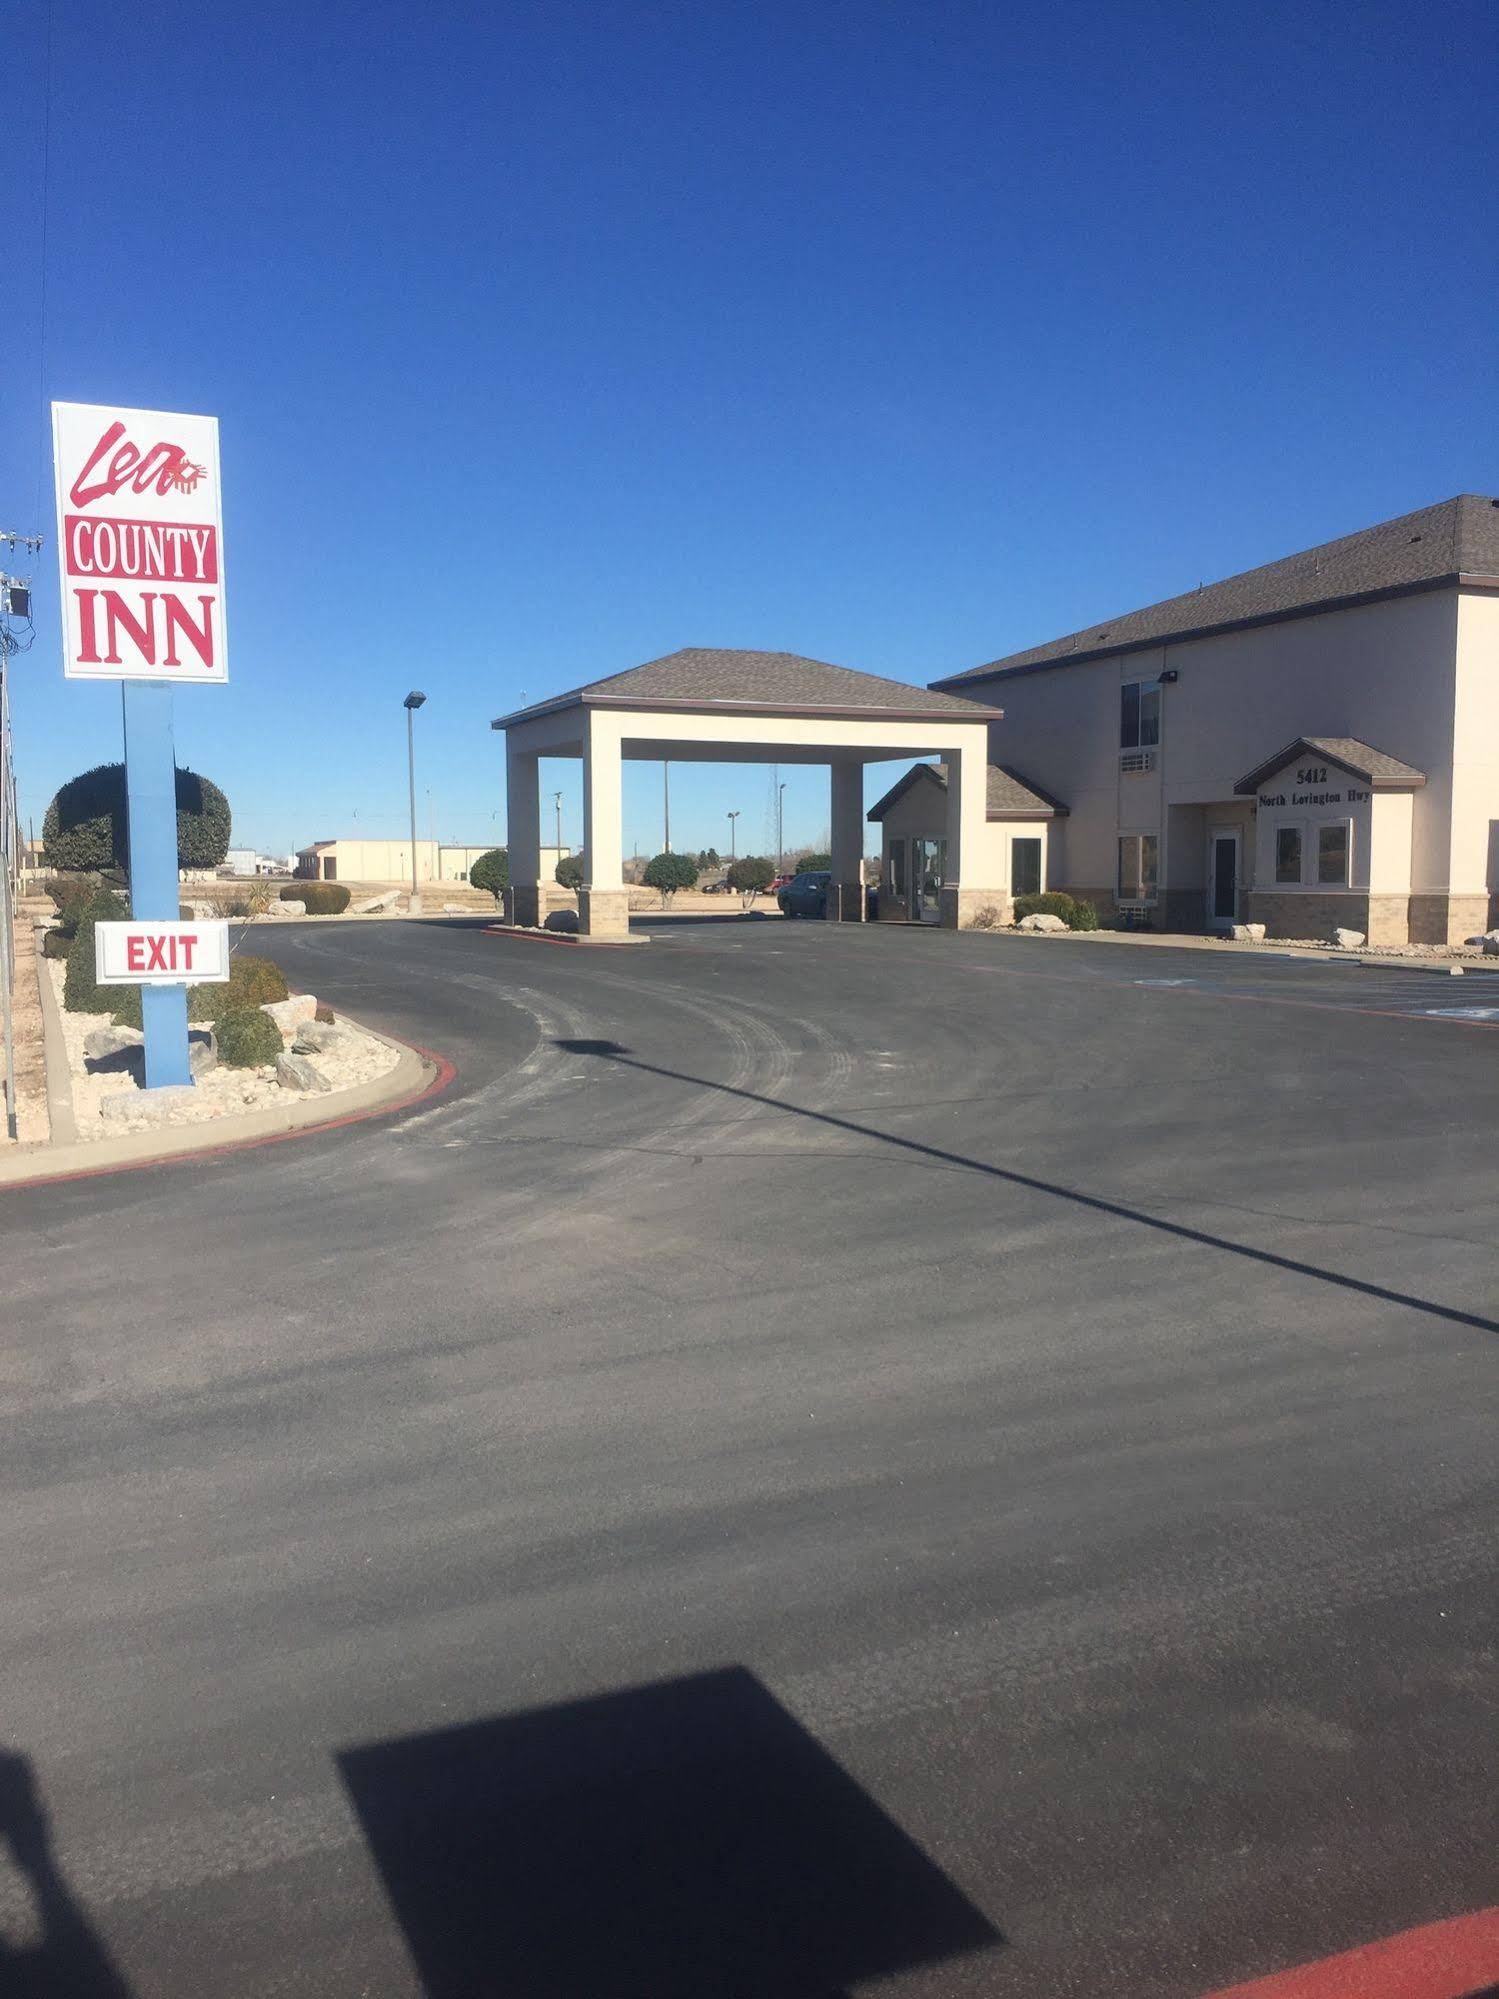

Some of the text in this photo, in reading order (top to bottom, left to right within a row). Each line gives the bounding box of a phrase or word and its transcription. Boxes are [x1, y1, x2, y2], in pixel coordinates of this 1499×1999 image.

[70, 421, 187, 508] Lea
[73, 521, 210, 579] COUNTY
[73, 588, 215, 668] INN
[1259, 789, 1370, 807] North Lovington Hwy
[1296, 768, 1327, 785] 5412
[127, 935, 198, 971] EXIT
